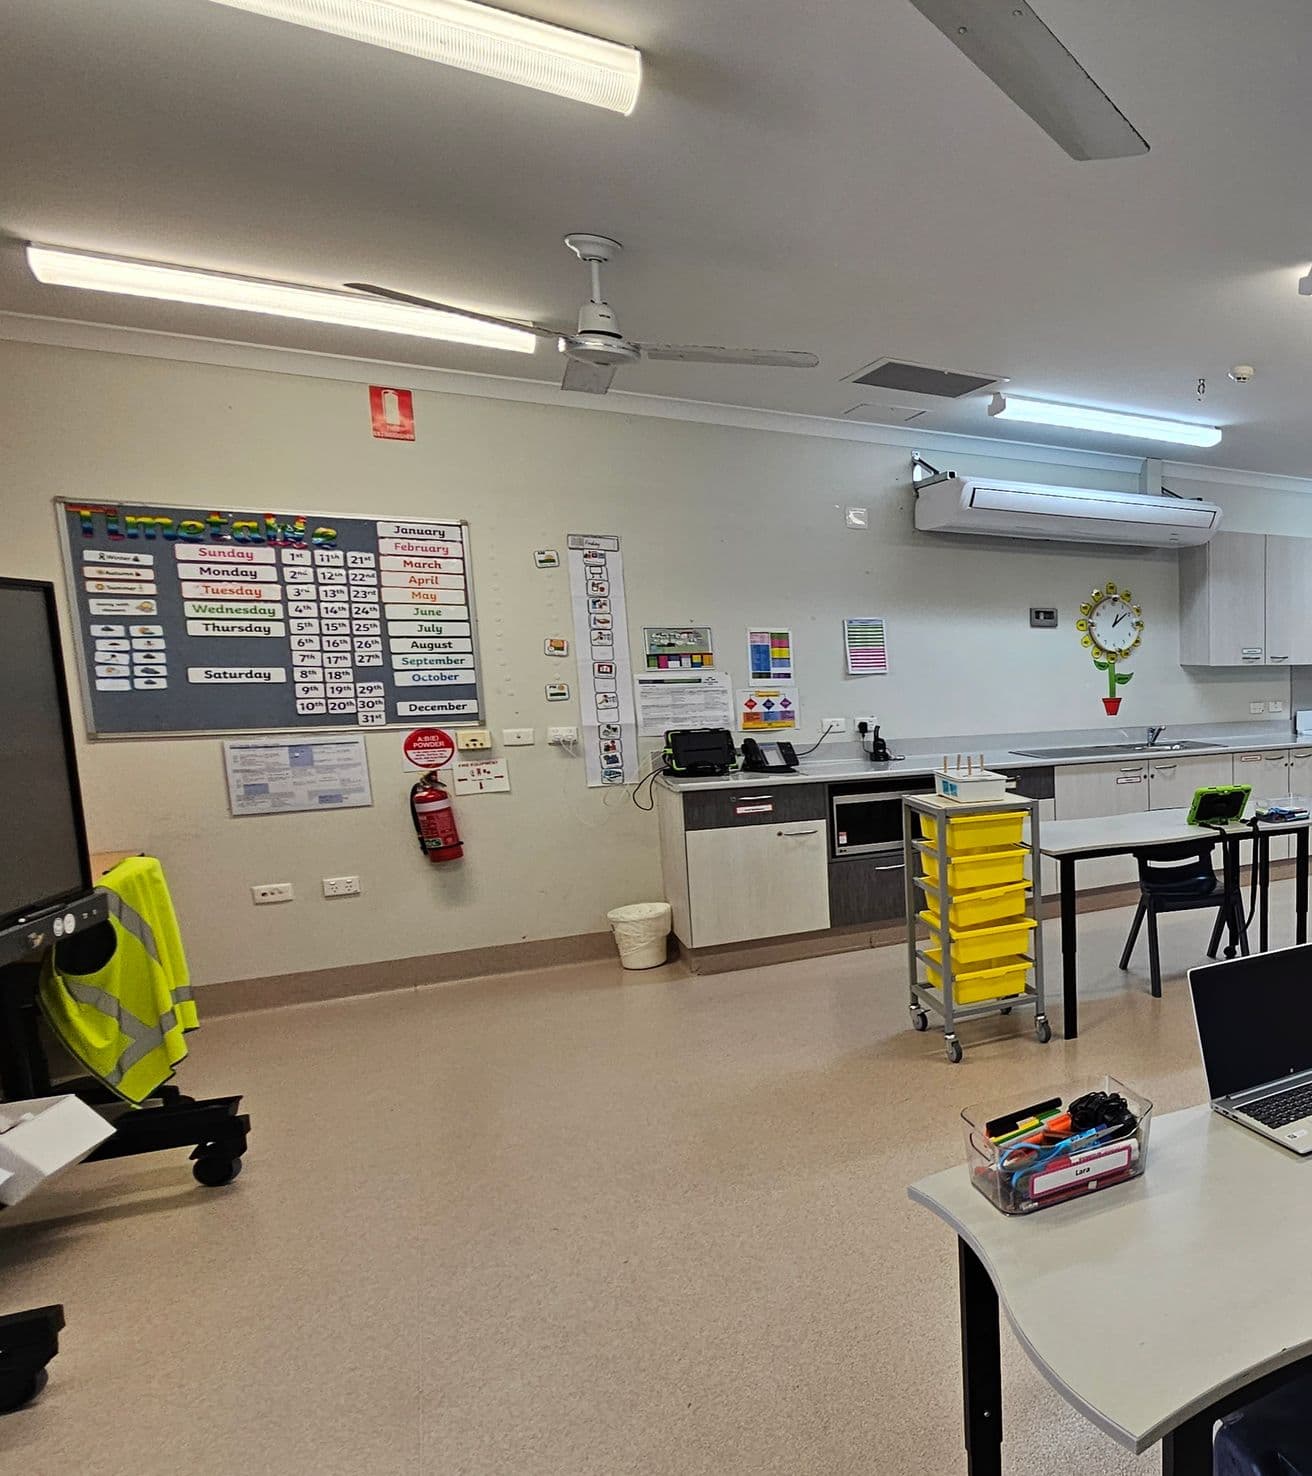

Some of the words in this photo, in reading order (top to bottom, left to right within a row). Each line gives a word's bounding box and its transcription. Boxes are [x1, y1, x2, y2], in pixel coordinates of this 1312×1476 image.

[393, 526, 446, 538] January
[394, 543, 449, 555] February
[198, 547, 254, 561] Sunday
[290, 553, 304, 561] 1st
[351, 556, 372, 564] 21st
[402, 560, 442, 569] March
[199, 567, 257, 579] Monday
[351, 572, 376, 581] 22nd
[408, 575, 439, 586] April
[201, 585, 262, 598] Tuesday
[323, 588, 345, 598] 13th
[352, 590, 377, 599] 23rd
[411, 591, 437, 602] May
[192, 603, 276, 617] Wednesday
[294, 605, 312, 613] 4th
[323, 606, 346, 614] 14th
[354, 606, 378, 615] 24th
[413, 607, 442, 616] June
[202, 622, 271, 635] Thursday
[296, 622, 313, 631] 5th
[324, 622, 347, 631] 15th
[355, 623, 378, 631] 25th
[416, 624, 443, 634] July
[297, 639, 314, 647] 6th
[325, 639, 348, 648] 16th
[356, 640, 379, 649] 26th
[410, 641, 453, 651] August
[298, 654, 315, 663] 7th
[326, 655, 348, 664] 17th
[357, 654, 380, 663] 27th
[401, 656, 466, 667] September
[204, 670, 271, 681] Saturday
[300, 670, 317, 679] 8th
[327, 671, 350, 680] 18th
[411, 672, 460, 681] October
[301, 685, 318, 694] 9th
[330, 686, 352, 694] 19th
[358, 685, 382, 694] 29th
[299, 701, 324, 711] 10th
[329, 701, 355, 710] 20th
[358, 700, 383, 709] 30th
[408, 702, 468, 712] December
[361, 714, 383, 723] 31st
[412, 740, 446, 749] POWDER
[1075, 1166, 1091, 1176] Lara
